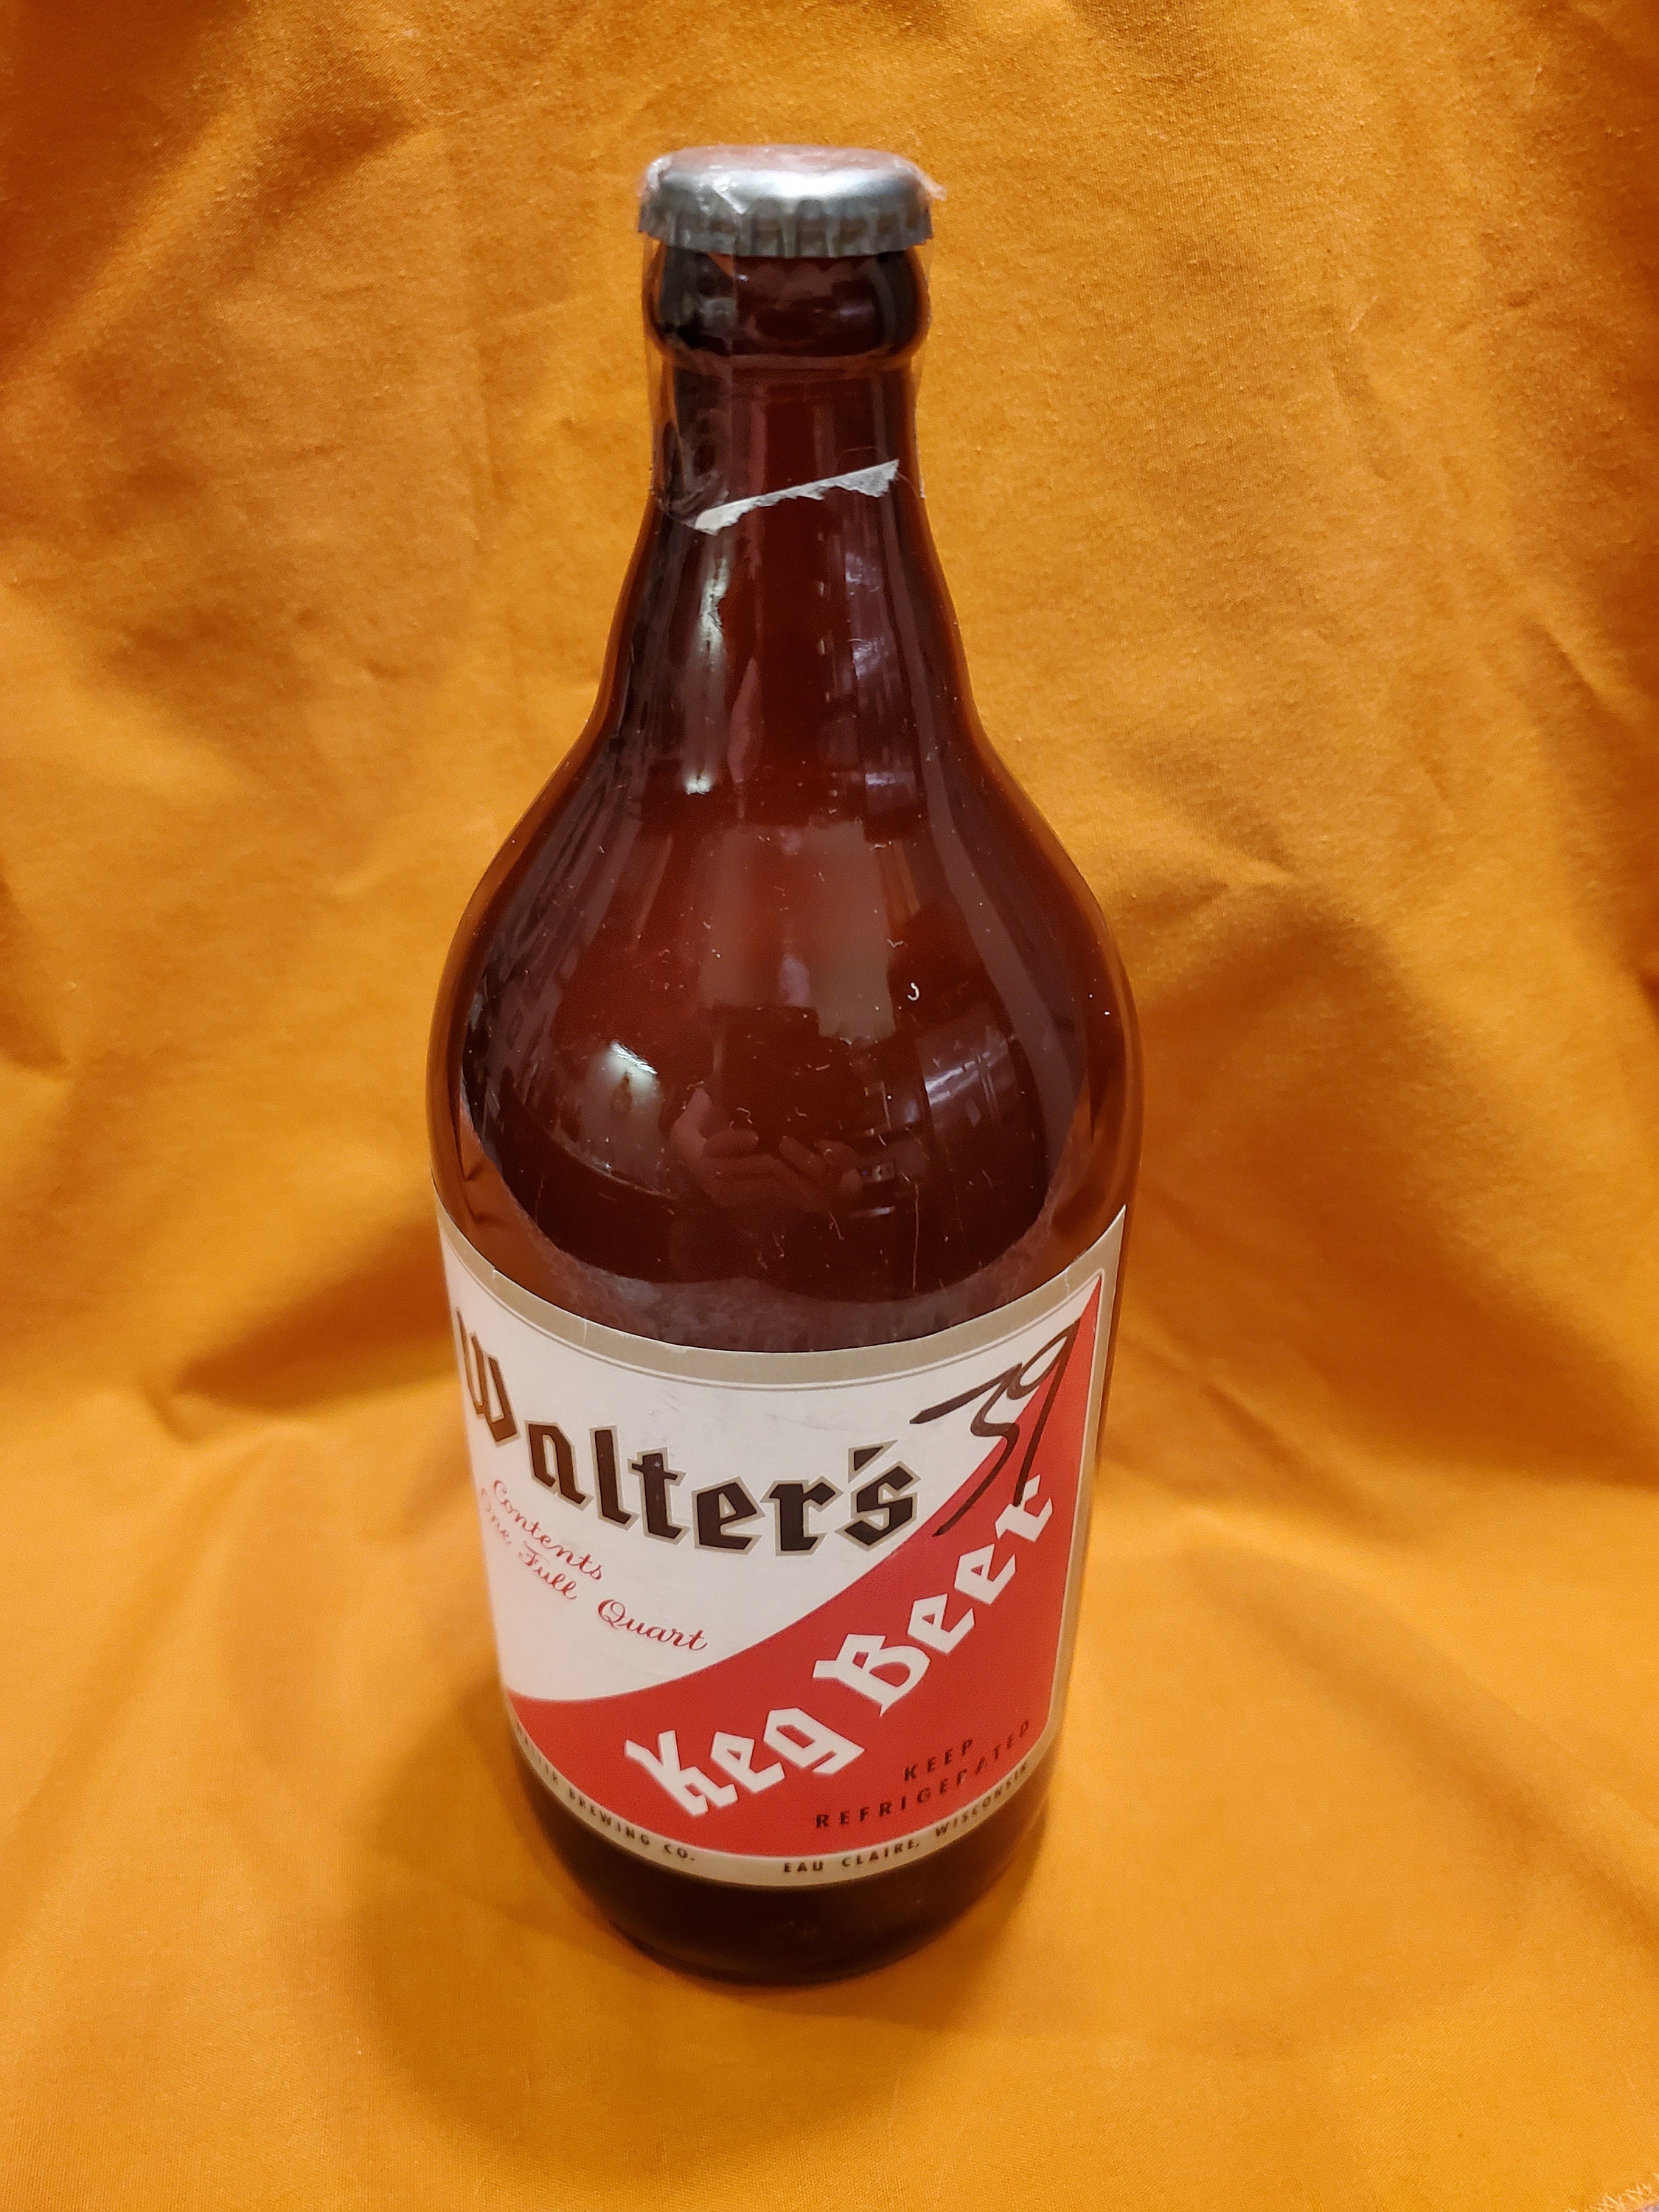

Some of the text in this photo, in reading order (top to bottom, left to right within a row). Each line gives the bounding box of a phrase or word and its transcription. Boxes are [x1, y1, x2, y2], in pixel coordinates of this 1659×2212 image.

[456, 1307, 921, 1556] Walter's
[481, 1488, 708, 1651] One Full Quart
[493, 1480, 602, 1580] Contents
[625, 1475, 1053, 1817] Keg Beer
[815, 1719, 1029, 1828] REFRIGERATED
[904, 1738, 973, 1781] KEEP
[569, 1788, 650, 1846] BREWING
[664, 1843, 695, 1862] CO.
[784, 1760, 1027, 1873] EAU CLAIRE, WISCONSIN
